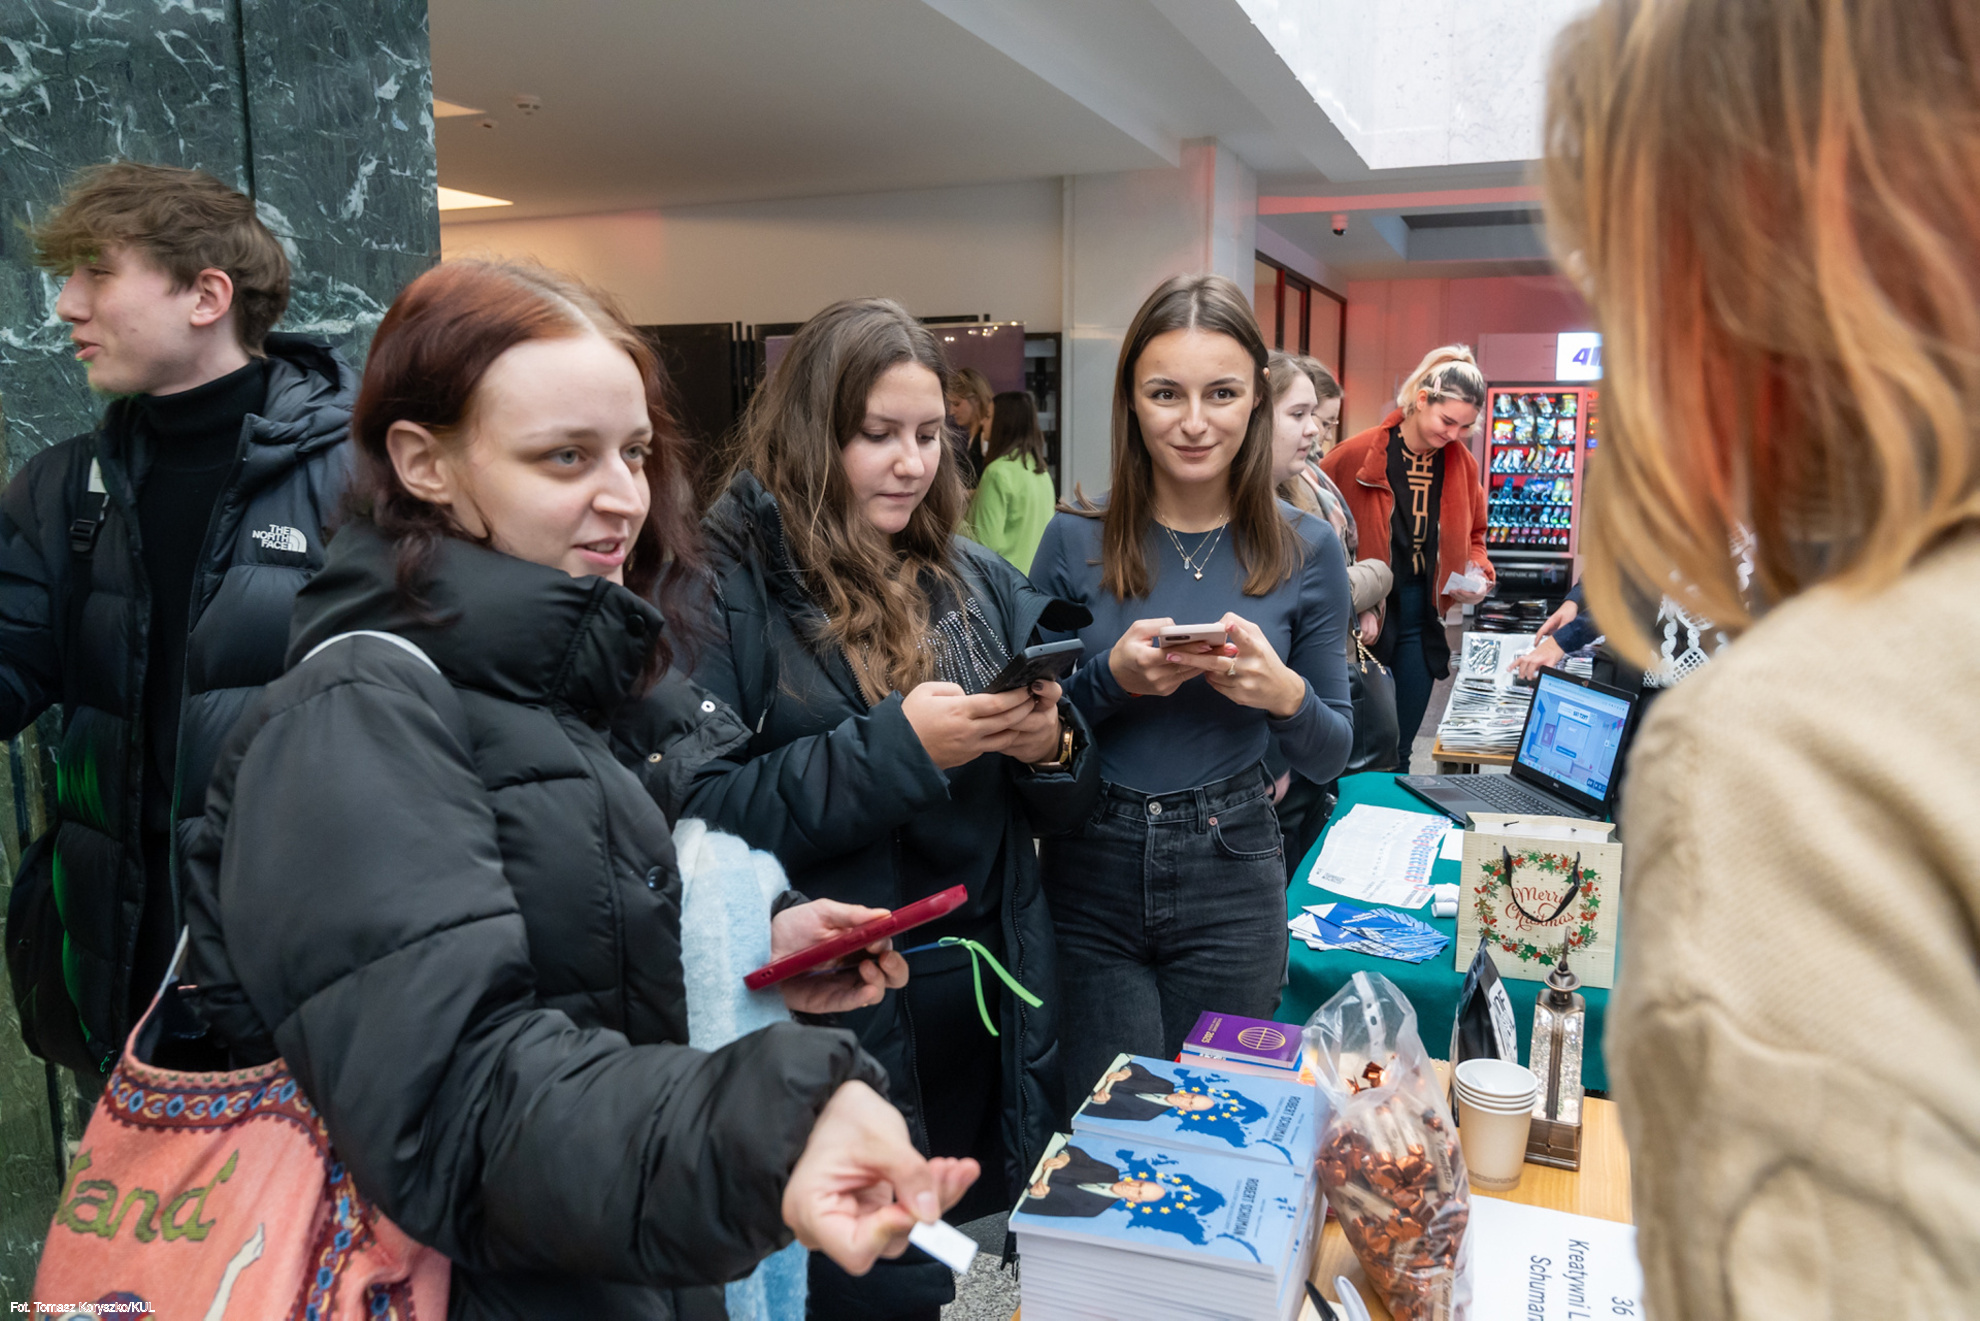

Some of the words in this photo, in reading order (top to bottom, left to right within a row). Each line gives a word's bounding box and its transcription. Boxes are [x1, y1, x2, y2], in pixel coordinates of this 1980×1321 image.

[252, 530, 290, 542] NORTH
[269, 524, 291, 536] THE
[261, 538, 289, 550] FACE
[1283, 1095, 1302, 1117] ROBERT
[1271, 1116, 1292, 1142] SCHUMAN
[1242, 1177, 1260, 1204] ROBERT
[1233, 1204, 1253, 1236] SCHUMAN
[1562, 1238, 1592, 1310] Kreatywni
[1611, 1296, 1635, 1317] 36
